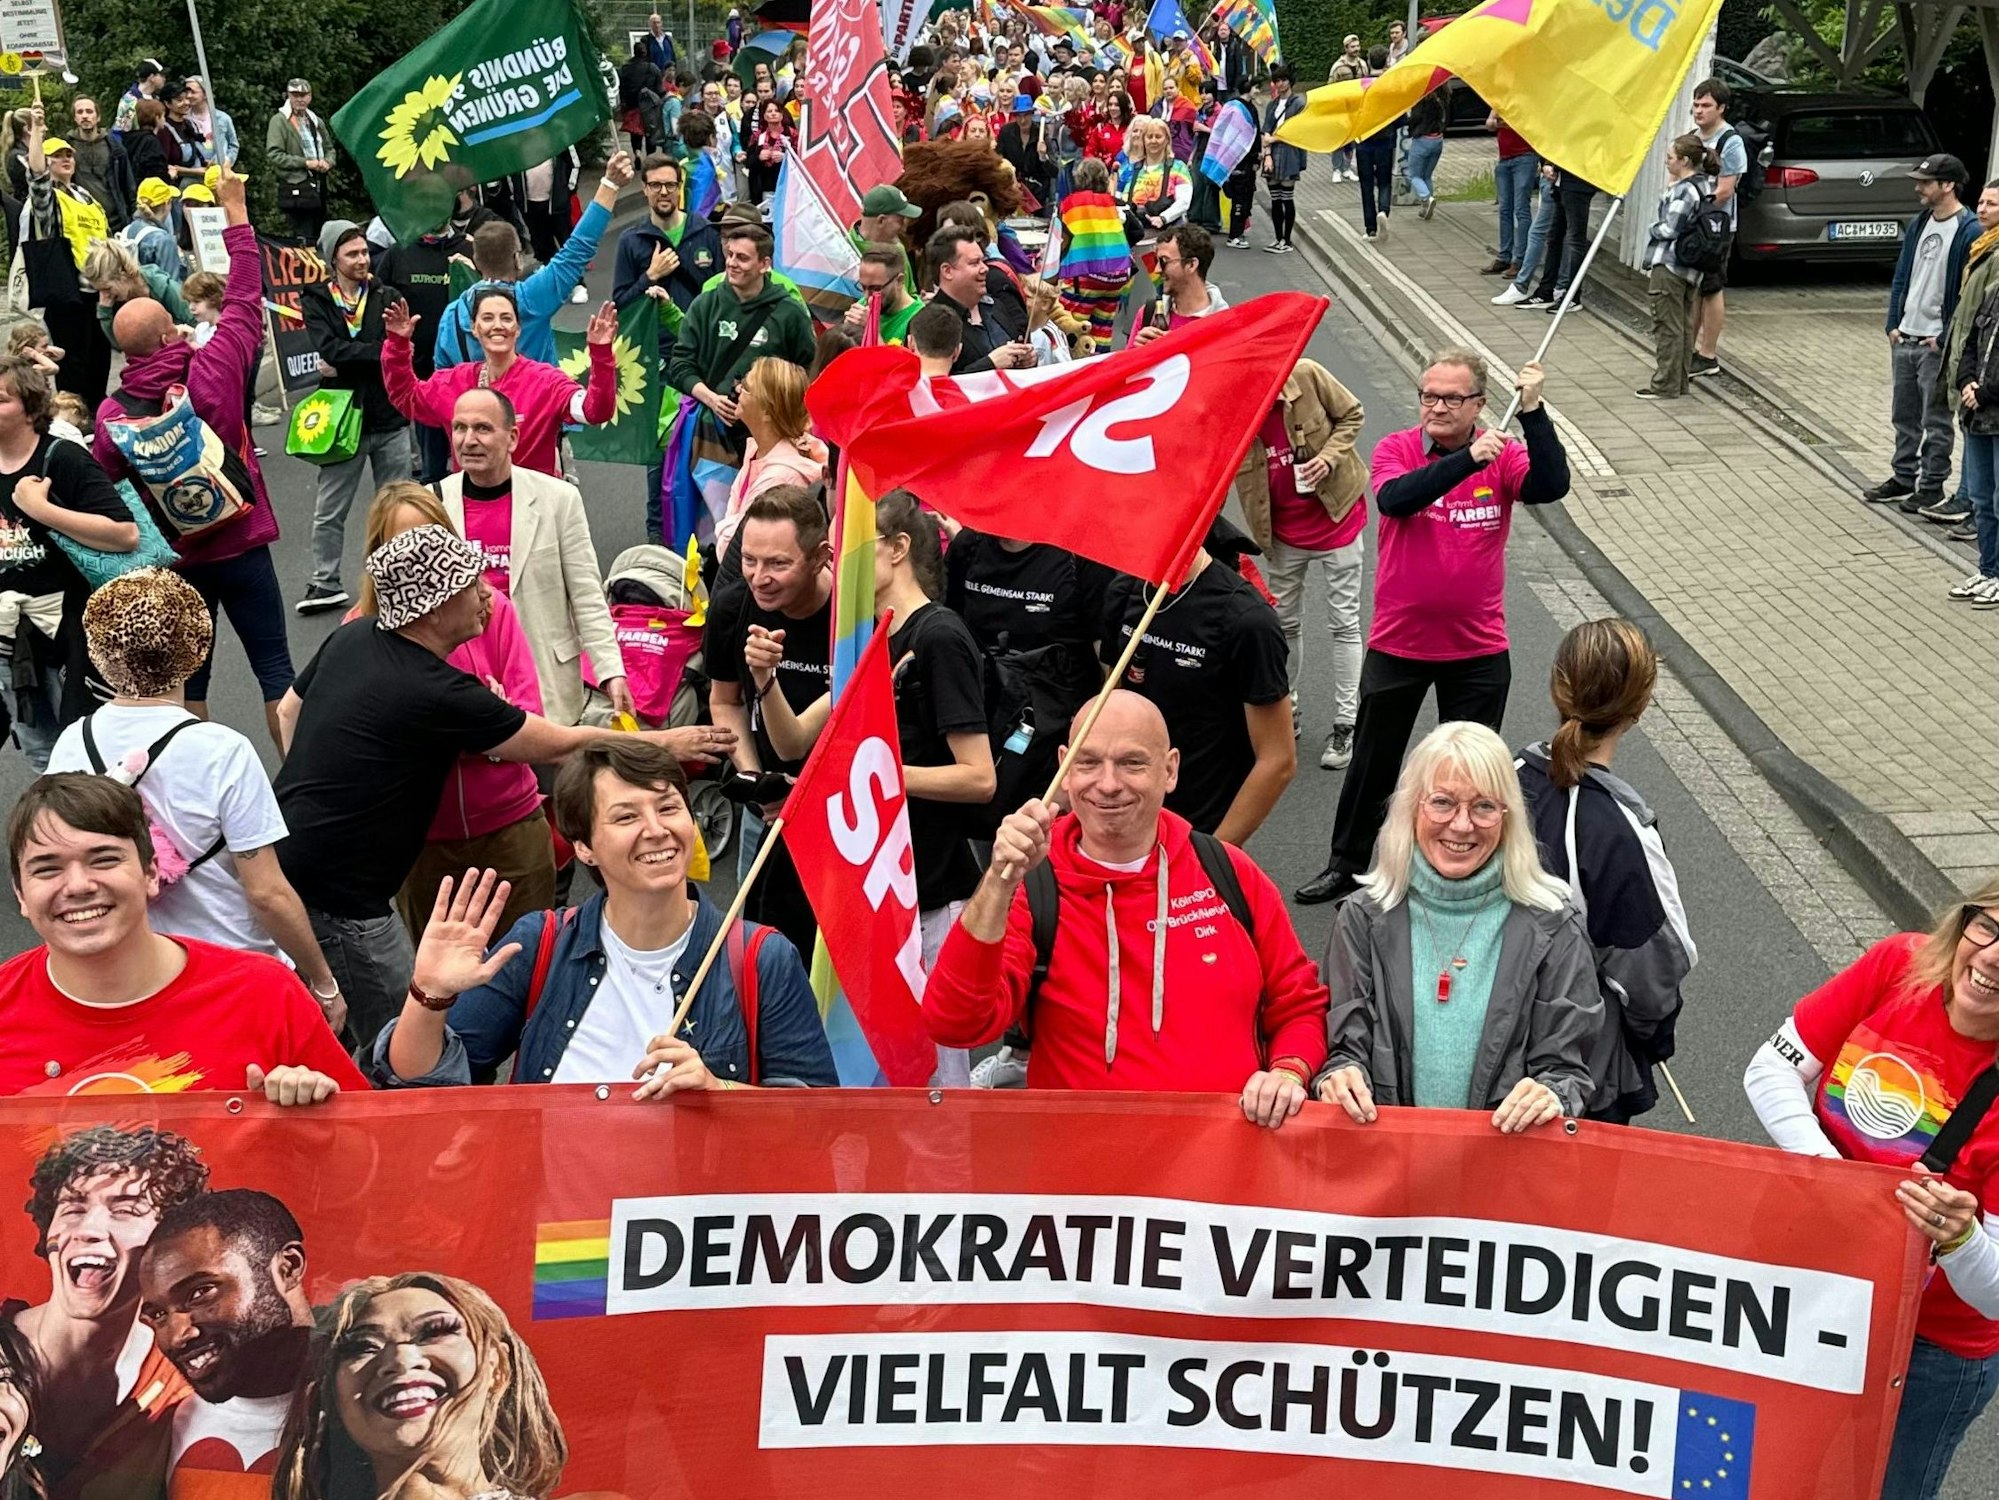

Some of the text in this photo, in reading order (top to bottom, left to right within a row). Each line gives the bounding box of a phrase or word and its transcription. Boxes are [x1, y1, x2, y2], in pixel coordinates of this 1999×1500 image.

[617, 631, 669, 646] FARBEN
[1175, 642, 1206, 658] STARK!
[777, 660, 821, 673] MEINSAM.
[1194, 925, 1218, 939] Dirk
[1770, 1033, 1805, 1067] NER
[622, 1212, 1187, 1291] DEMOKRATIE
[1209, 1224, 1792, 1359] VERTEIDIGEN
[783, 1349, 1655, 1475] VIELFALT SCHÜTZEN!
